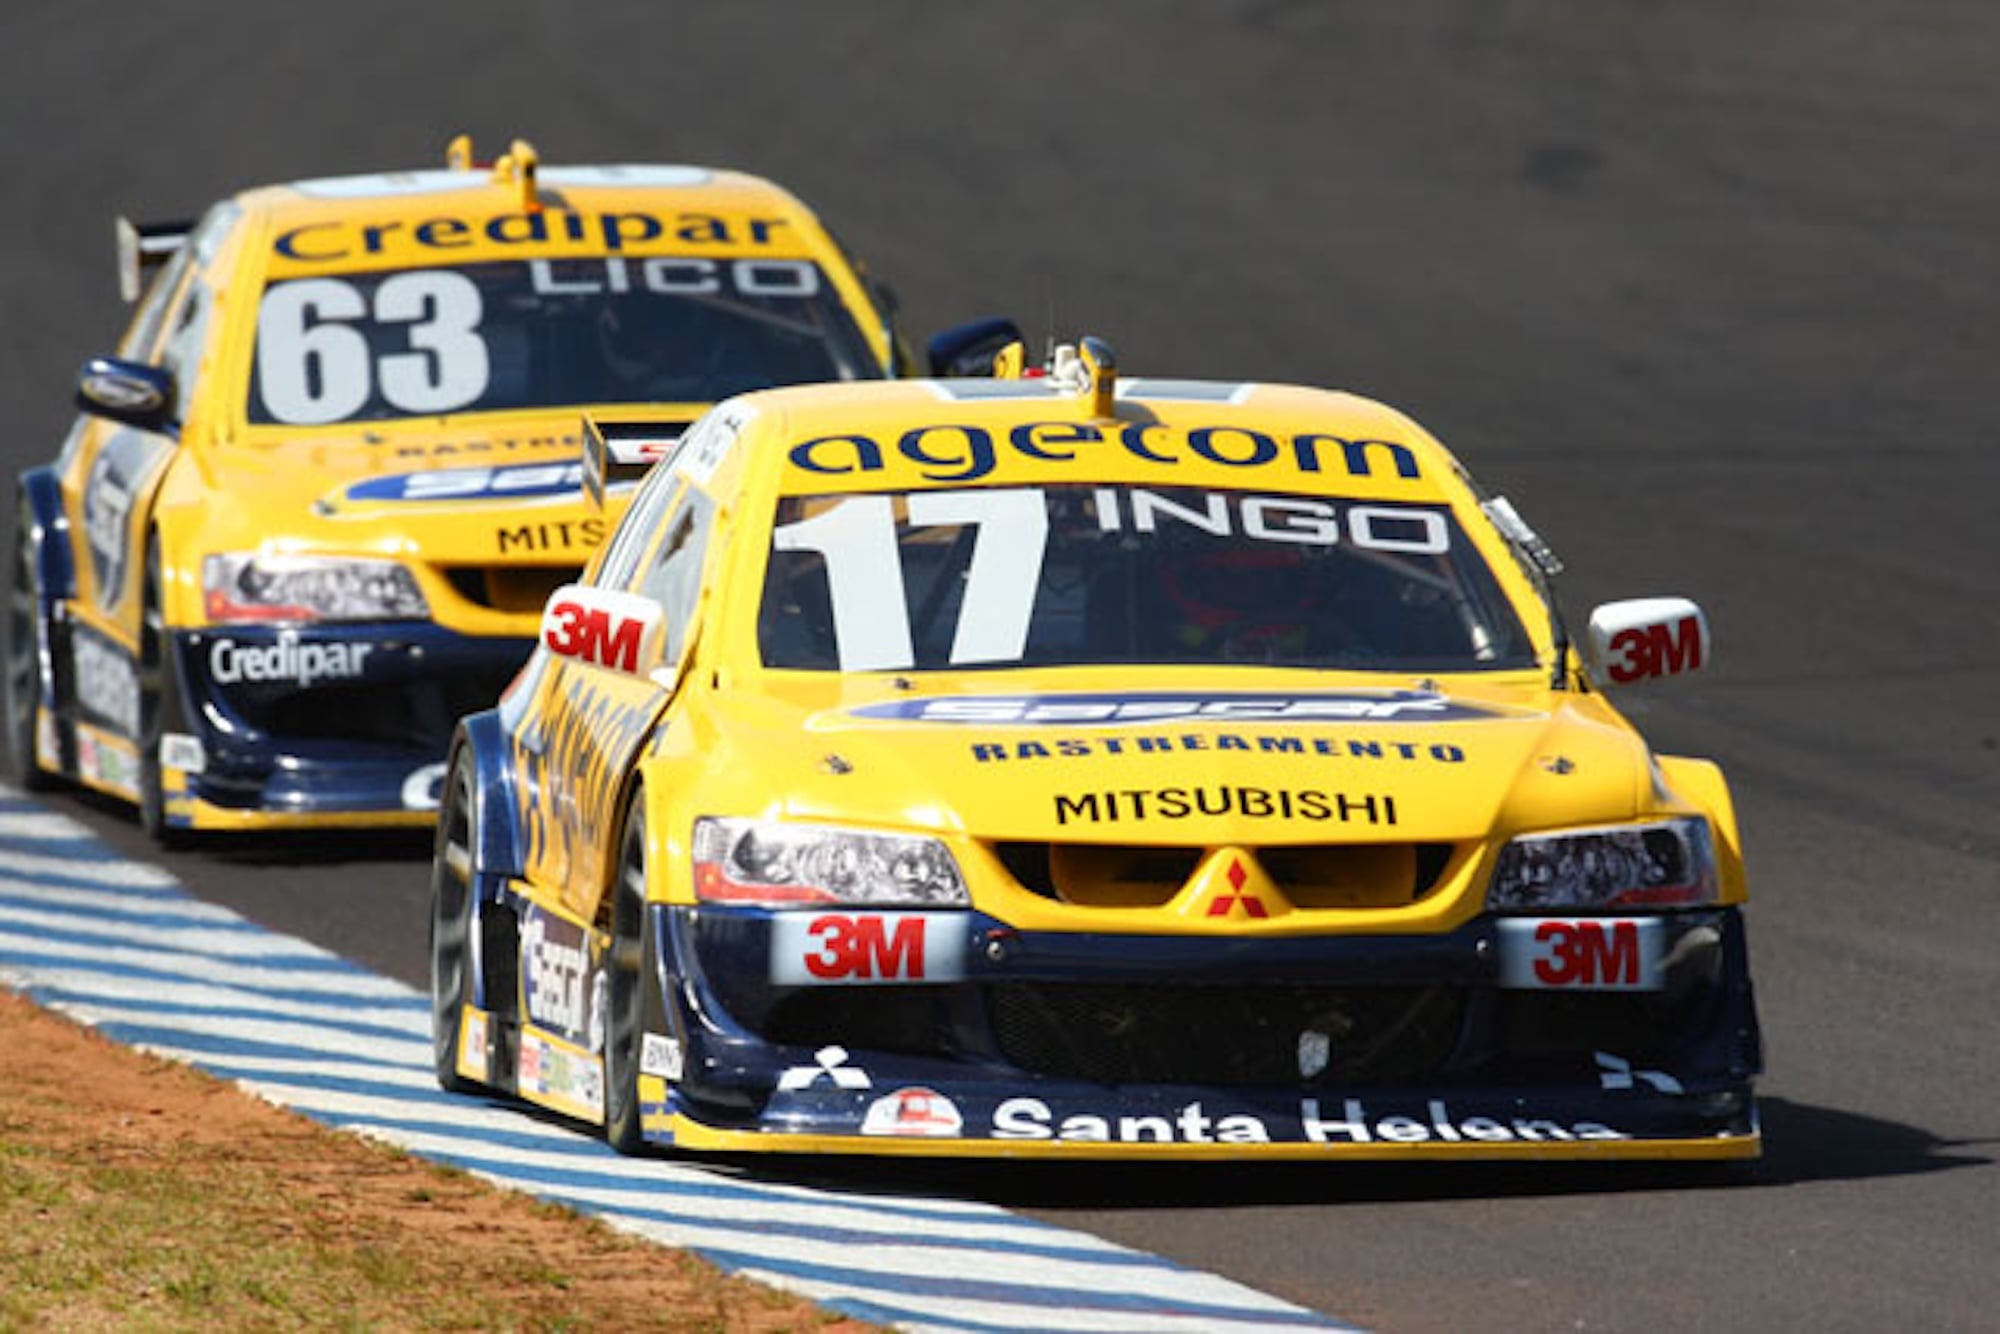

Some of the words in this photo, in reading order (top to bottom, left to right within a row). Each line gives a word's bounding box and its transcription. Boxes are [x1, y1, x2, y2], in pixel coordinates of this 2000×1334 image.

[273, 207, 789, 261] Credipar
[530, 257, 818, 296] LICO
[255, 270, 491, 425] 63
[788, 420, 1422, 481] agecom
[1093, 488, 1452, 555] INGO
[774, 488, 1050, 672] 17
[210, 637, 373, 686] Credipar
[546, 601, 645, 674] 3M
[1607, 616, 1702, 684] 3M
[970, 734, 1467, 764] RASTREAMENTO
[1053, 787, 1400, 826] MITSUBISHI
[803, 914, 926, 981] 3M
[1532, 920, 1640, 985] 3M
[990, 1098, 1271, 1142] Santa
[1300, 1098, 1634, 1142] Helena
